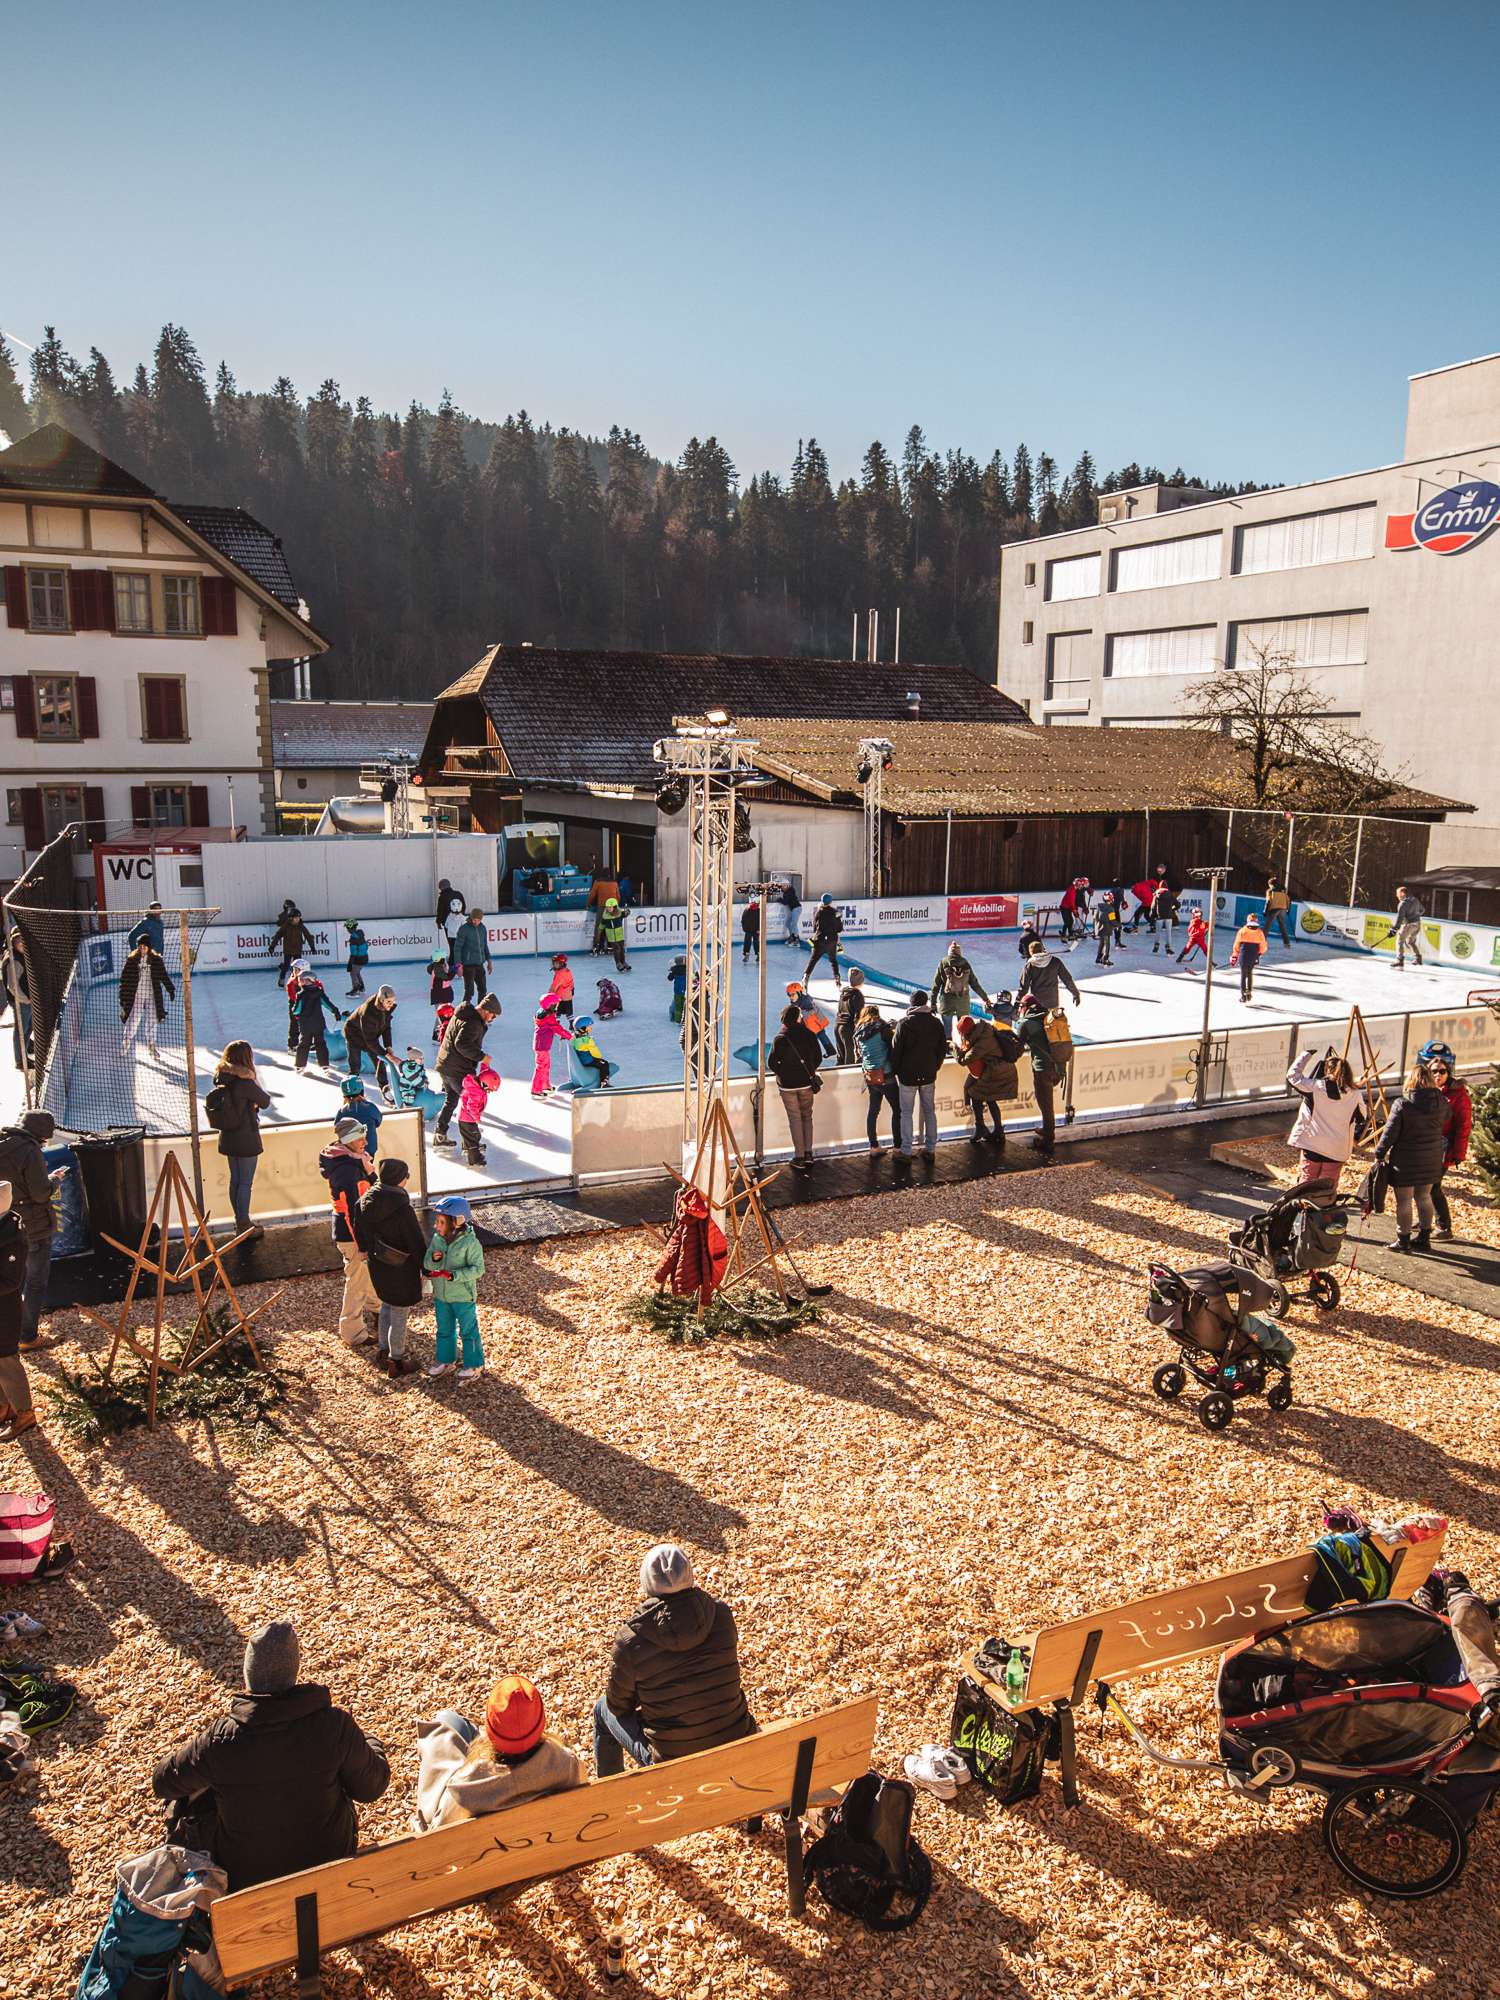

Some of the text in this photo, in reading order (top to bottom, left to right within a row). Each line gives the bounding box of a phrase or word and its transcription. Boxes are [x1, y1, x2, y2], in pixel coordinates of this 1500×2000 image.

[1420, 497, 1497, 531] Emmi
[107, 858, 153, 881] WC
[878, 906, 929, 920] emmenland
[367, 934, 433, 947] seierholzbau
[488, 927, 528, 941] EISEN
